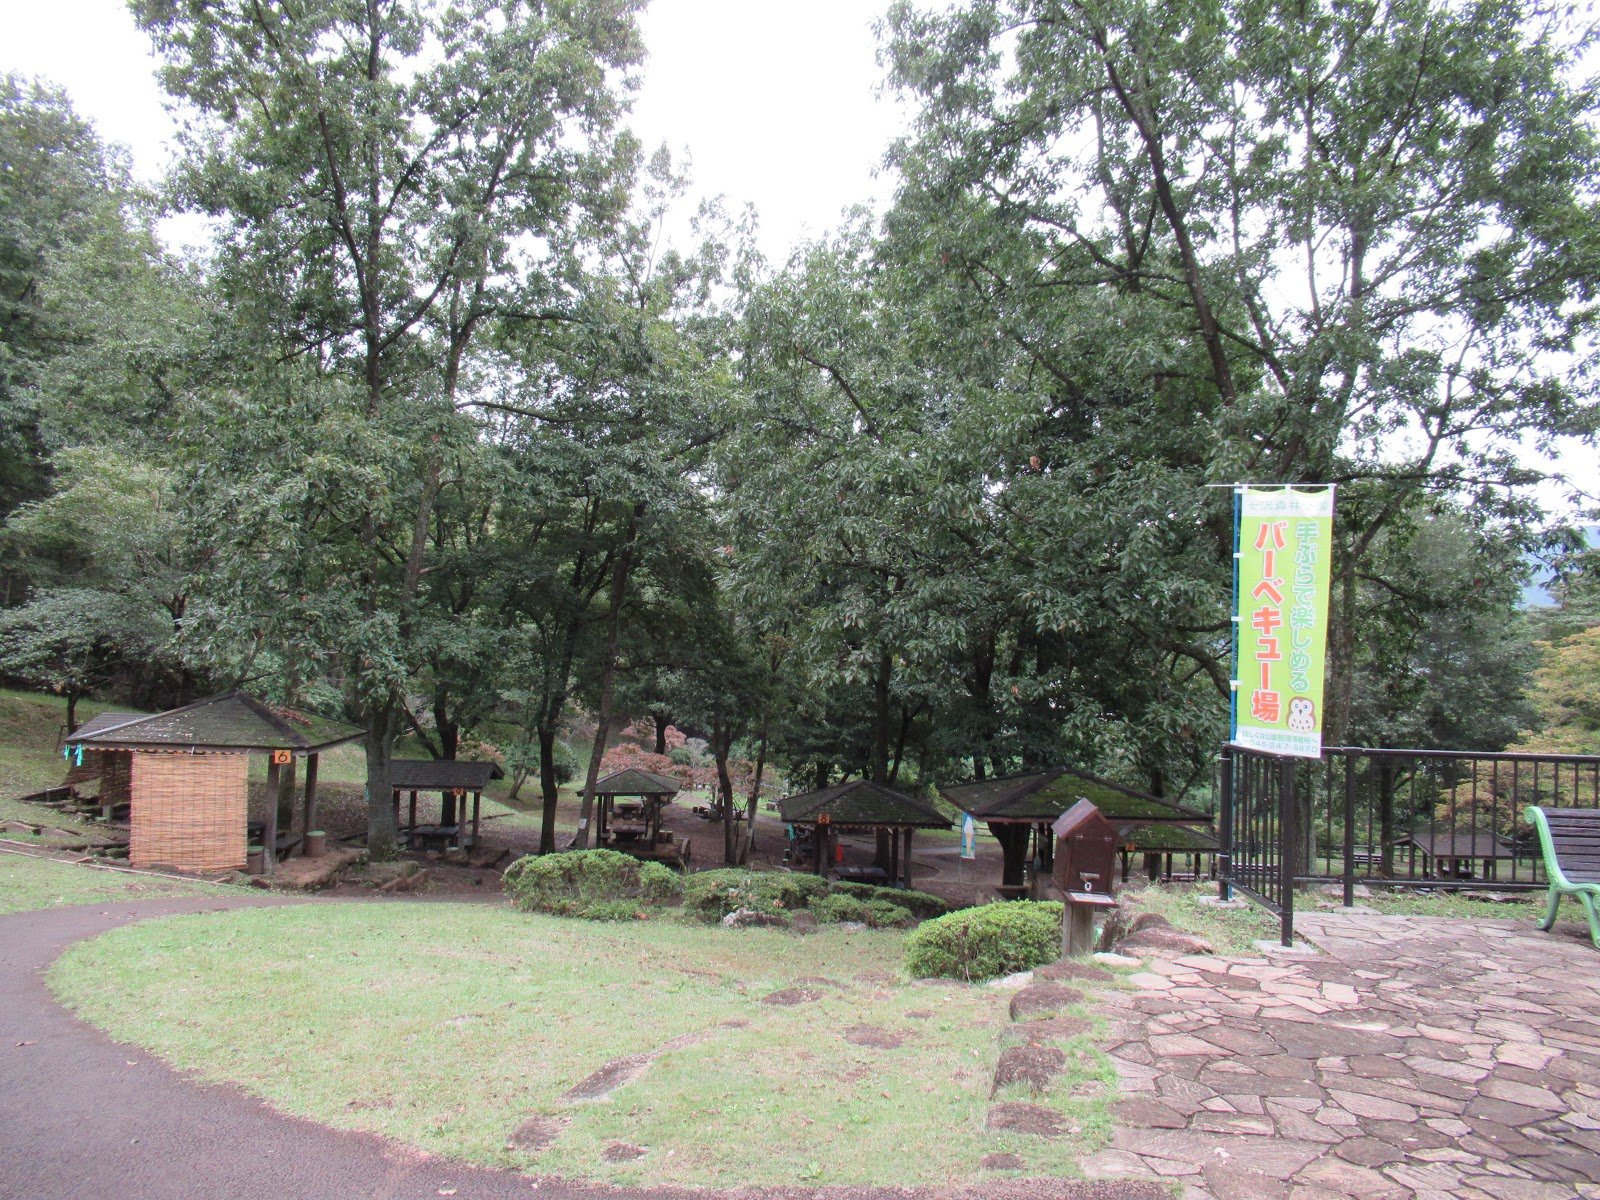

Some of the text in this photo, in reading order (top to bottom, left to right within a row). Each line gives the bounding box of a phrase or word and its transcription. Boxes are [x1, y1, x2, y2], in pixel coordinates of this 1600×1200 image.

[1252, 521, 1287, 724] バーベキュー場
[1290, 521, 1319, 693] 手ぶらで楽しめる
[278, 751, 288, 763] 6
